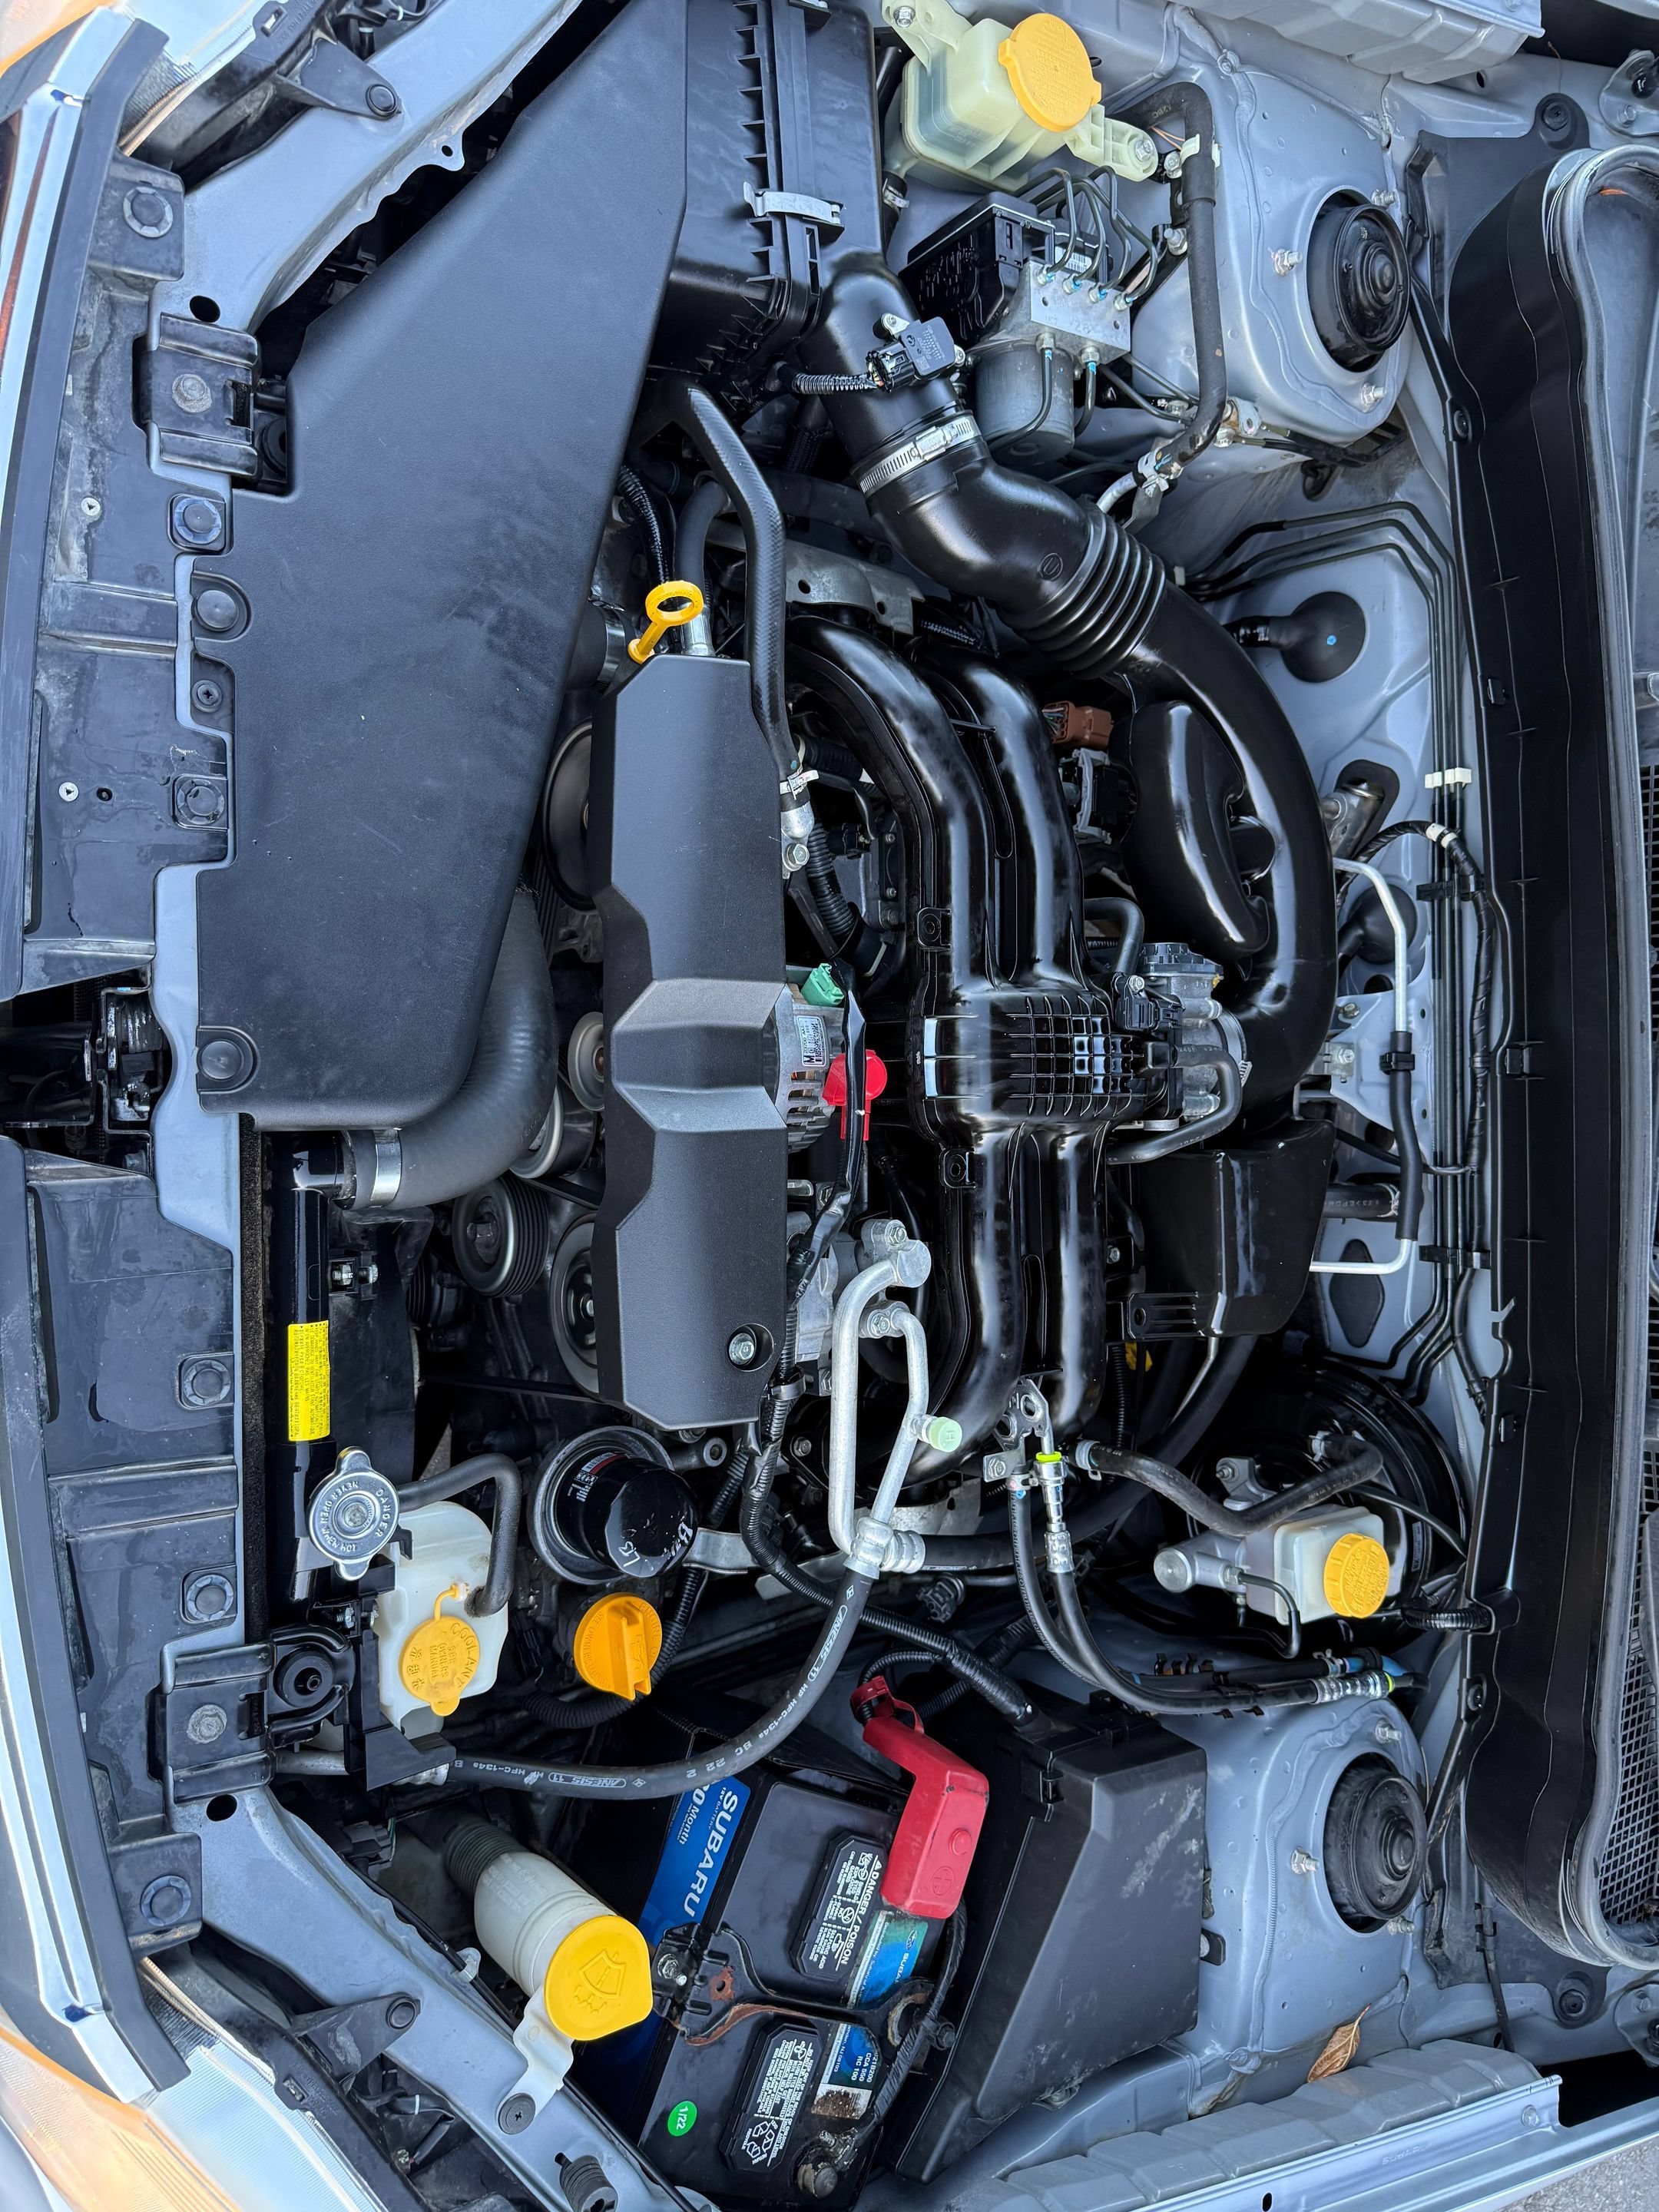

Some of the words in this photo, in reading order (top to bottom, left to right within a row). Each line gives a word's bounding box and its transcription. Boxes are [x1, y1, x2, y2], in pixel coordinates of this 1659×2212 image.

[945, 1430, 955, 1441] H
[331, 1481, 357, 1499] NEVER
[320, 1500, 332, 1524] OPEN
[375, 1488, 390, 1536] DANGER
[321, 1526, 337, 1548] WHEN
[340, 1542, 356, 1552] HOT
[639, 1603, 660, 1641] ENGINE
[429, 1645, 439, 1678] MANUAL
[437, 1643, 449, 1677] OWNERS
[451, 1622, 476, 1687] COOLANT
[798, 1683, 808, 1697] HP
[758, 1698, 797, 1739] HFC-134a
[734, 1740, 753, 1756] BC
[473, 1762, 525, 1774] HFC-134a
[686, 1769, 697, 1778] 2
[706, 1757, 726, 1772] 22
[679, 1804, 699, 1844] Month
[708, 1800, 721, 1830] BATTERY
[684, 1789, 737, 1916] SUBARU
[859, 1870, 879, 1915] DANGER
[823, 1929, 836, 1955] SULFURIC
[840, 1924, 859, 1964] POISON
[876, 1922, 889, 1950] Distributed
[818, 1955, 826, 1969] ACID
[865, 1960, 875, 1979] Subaru
[842, 2025, 851, 2045] amden,
[839, 2045, 845, 2054] NJ
[863, 2052, 872, 2067] CCA
[833, 2055, 842, 2072] 08103
[856, 2055, 863, 2066] RC
[859, 2068, 867, 2081] 550
[676, 2106, 688, 2129] 1/22
